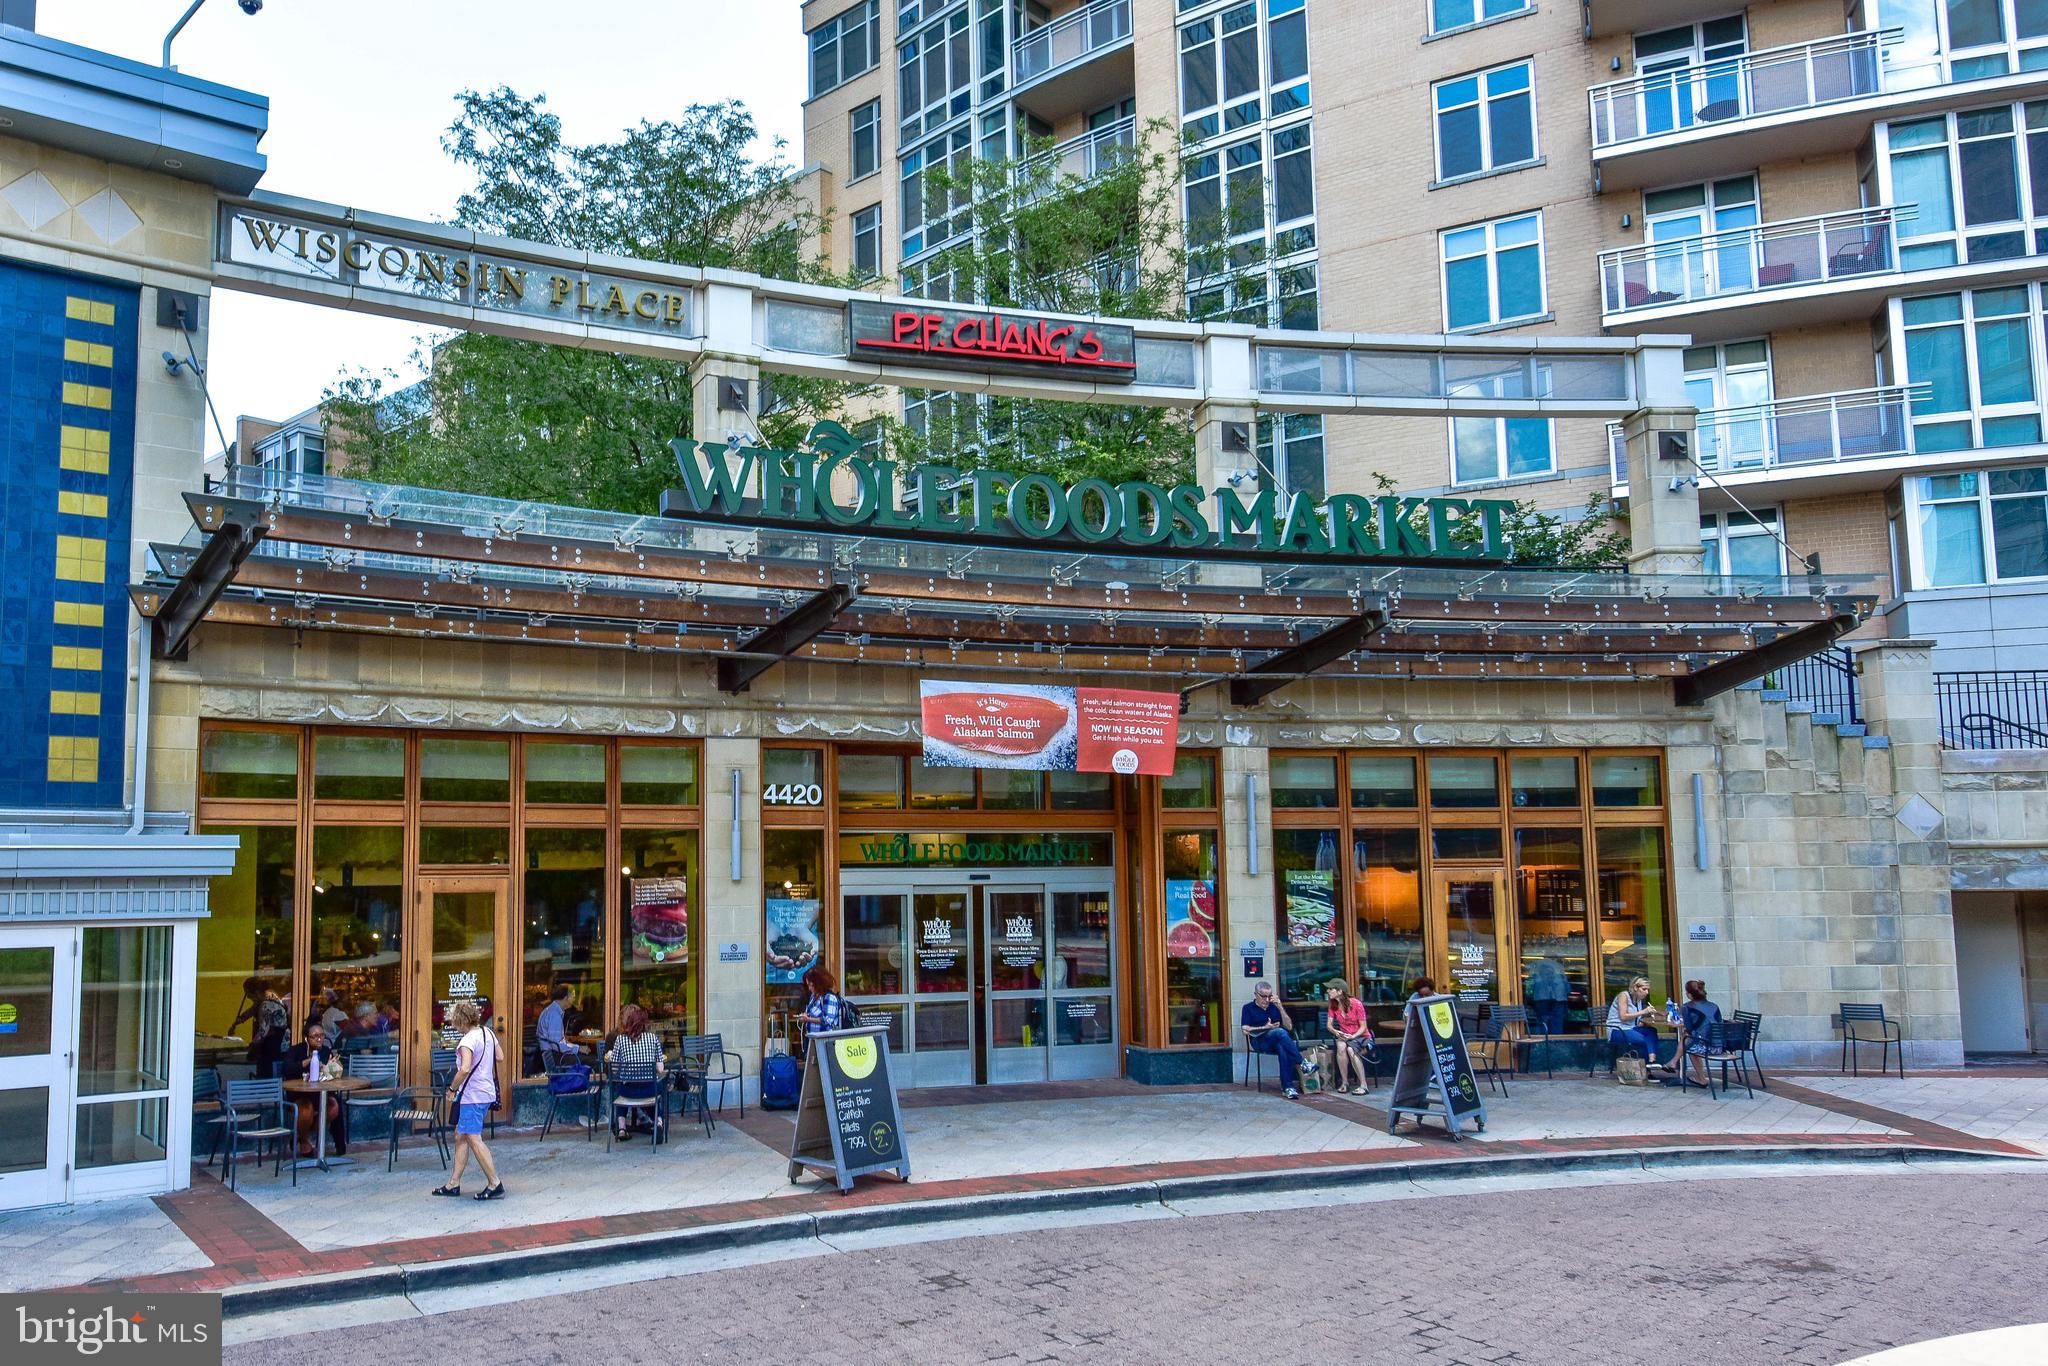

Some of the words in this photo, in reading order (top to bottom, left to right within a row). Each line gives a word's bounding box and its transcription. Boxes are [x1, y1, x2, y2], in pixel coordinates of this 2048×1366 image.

[238, 216, 528, 299] WISCONSIN
[550, 274, 687, 324] PLACE
[892, 311, 945, 352] P.F.
[952, 314, 1105, 364] CHANG'S
[667, 434, 965, 531] WHOLE
[970, 467, 1210, 548] FOODS
[1214, 487, 1517, 560] MARKET
[1135, 701, 1158, 710] straight
[1158, 702, 1173, 710] from
[1125, 708, 1144, 716] waters
[1145, 709, 1153, 717] of
[1153, 710, 1174, 718] Alaska.
[944, 714, 976, 727] Fresh,
[979, 715, 1003, 726] Wild
[1005, 716, 1041, 729] Caught
[953, 726, 994, 738] Alaskan
[997, 727, 1034, 739] Salmon
[1091, 724, 1111, 733] NOW
[1112, 725, 1121, 733] IN
[1124, 726, 1163, 736] SEASON!
[1107, 734, 1122, 742] fresh
[762, 783, 823, 805] 4420
[860, 840, 935, 861] WHOLE
[939, 842, 1005, 861] FOODS
[1007, 842, 1094, 862] MARKET
[923, 919, 951, 928] WHOLE
[1005, 918, 1033, 927] WHOLE
[924, 928, 950, 936] FOODS
[1007, 926, 1032, 934] FOODS
[448, 972, 477, 981] WHOLE
[450, 981, 476, 989] FOODS
[846, 1045, 867, 1058] Sale
[837, 1098, 855, 1109] Fresh
[856, 1096, 871, 1106] Blue
[839, 1108, 864, 1121] Catfish
[841, 1121, 860, 1134] Fillets
